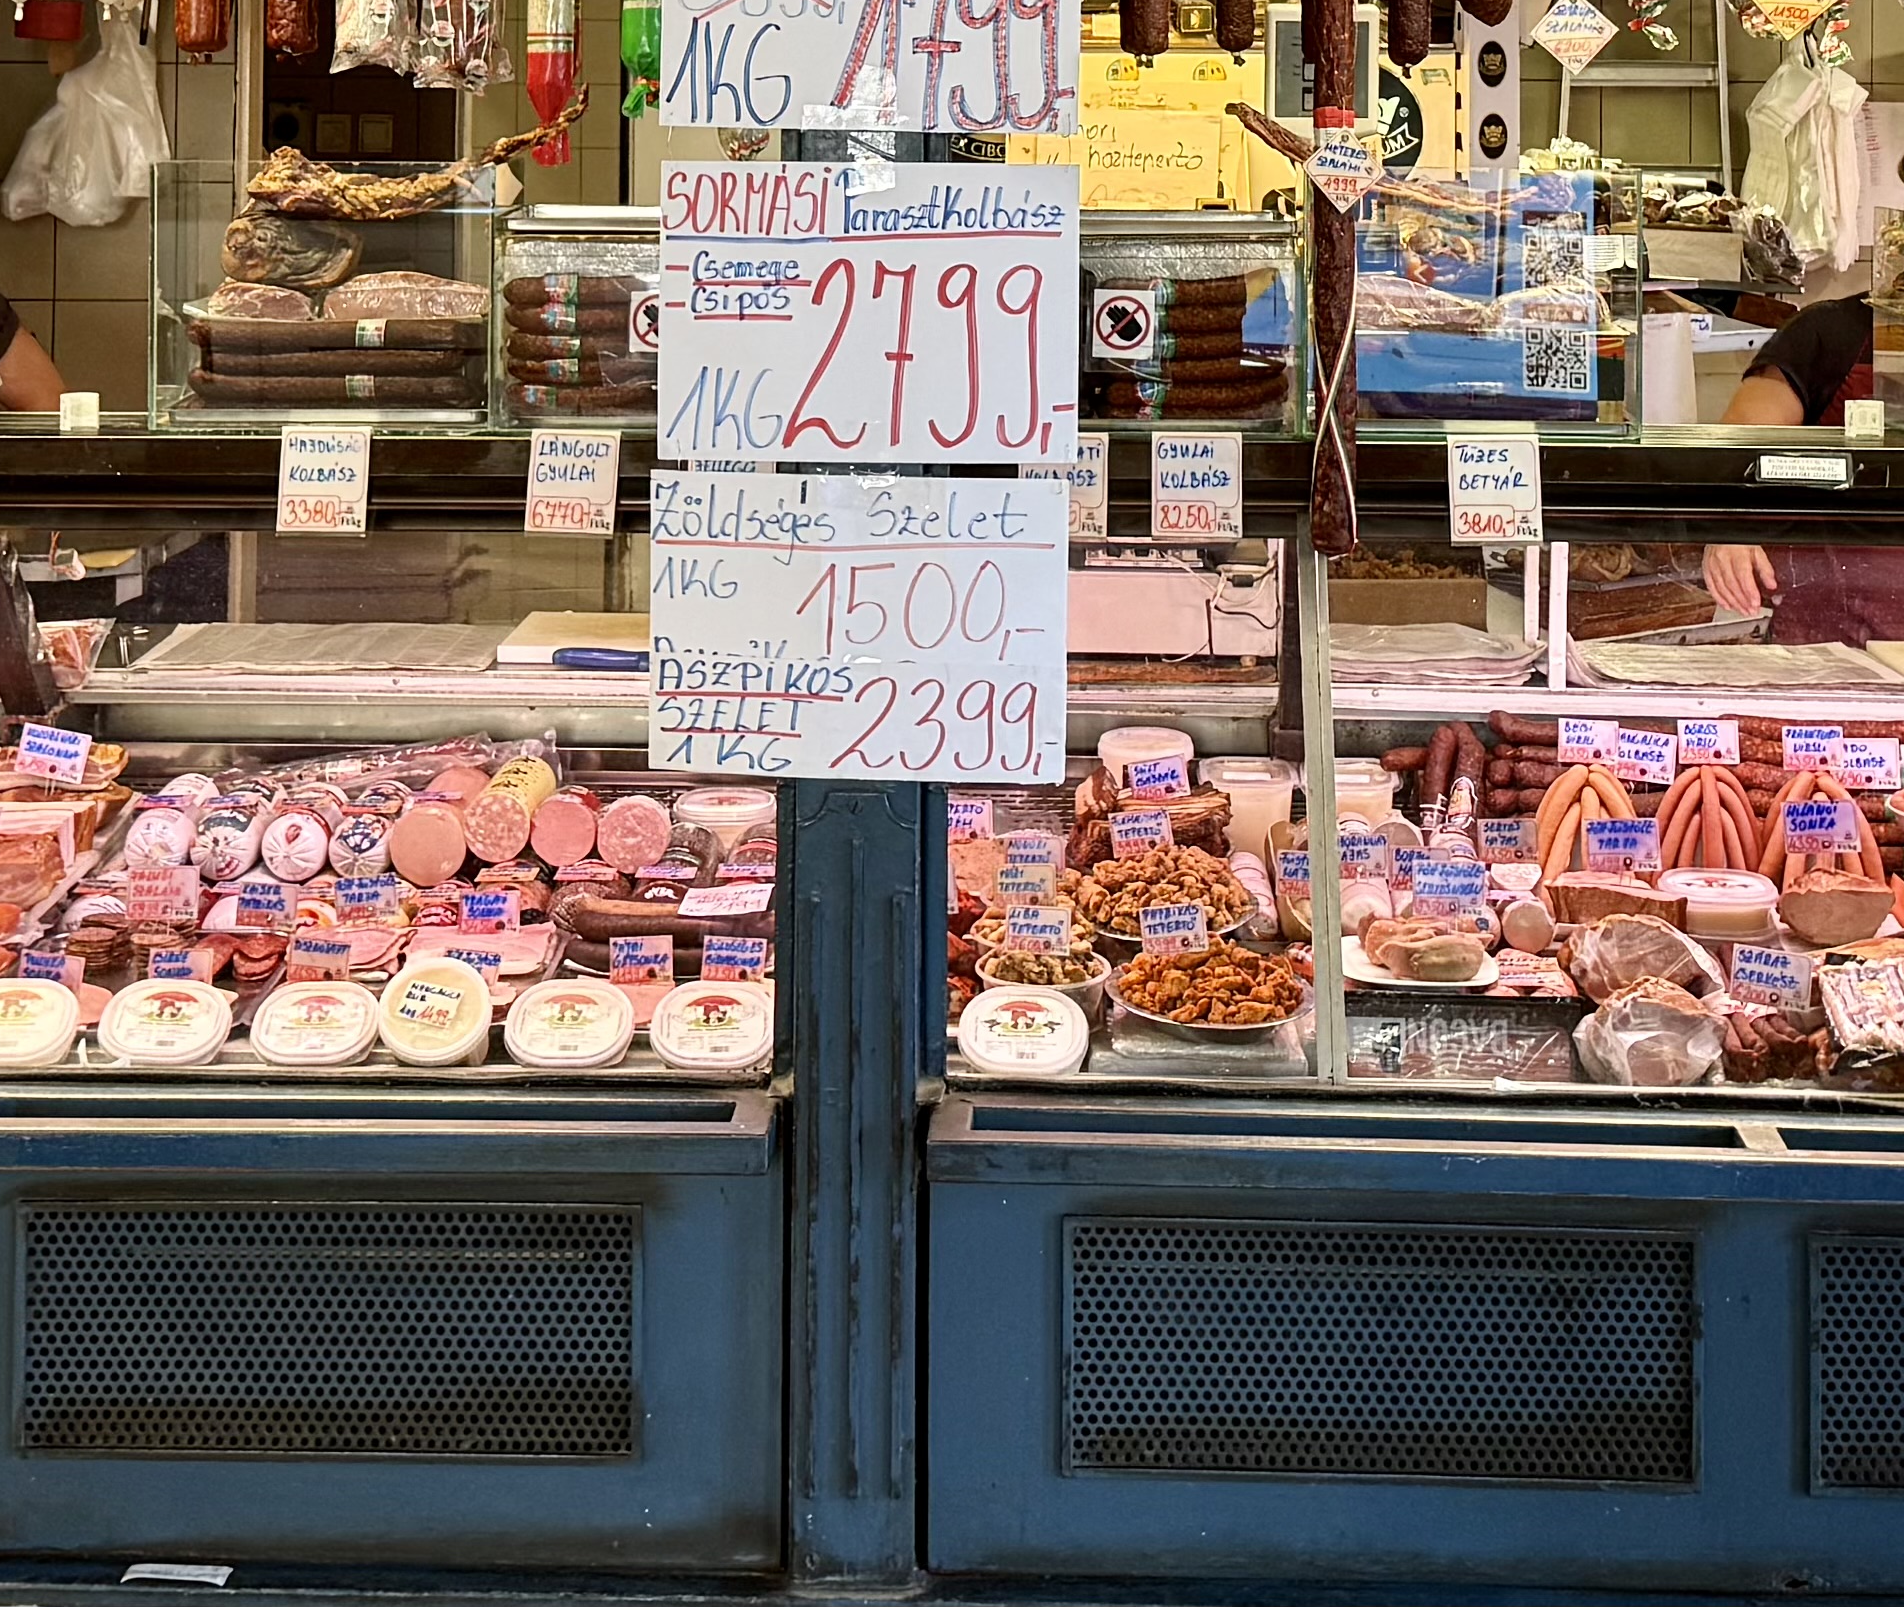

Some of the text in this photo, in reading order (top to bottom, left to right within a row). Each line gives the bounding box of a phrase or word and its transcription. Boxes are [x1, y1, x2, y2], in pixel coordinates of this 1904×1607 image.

[666, 17, 792, 124] 1KG
[867, 492, 1029, 540] Szelet
[653, 555, 741, 599] 1KG
[659, 697, 816, 732] SZELET
